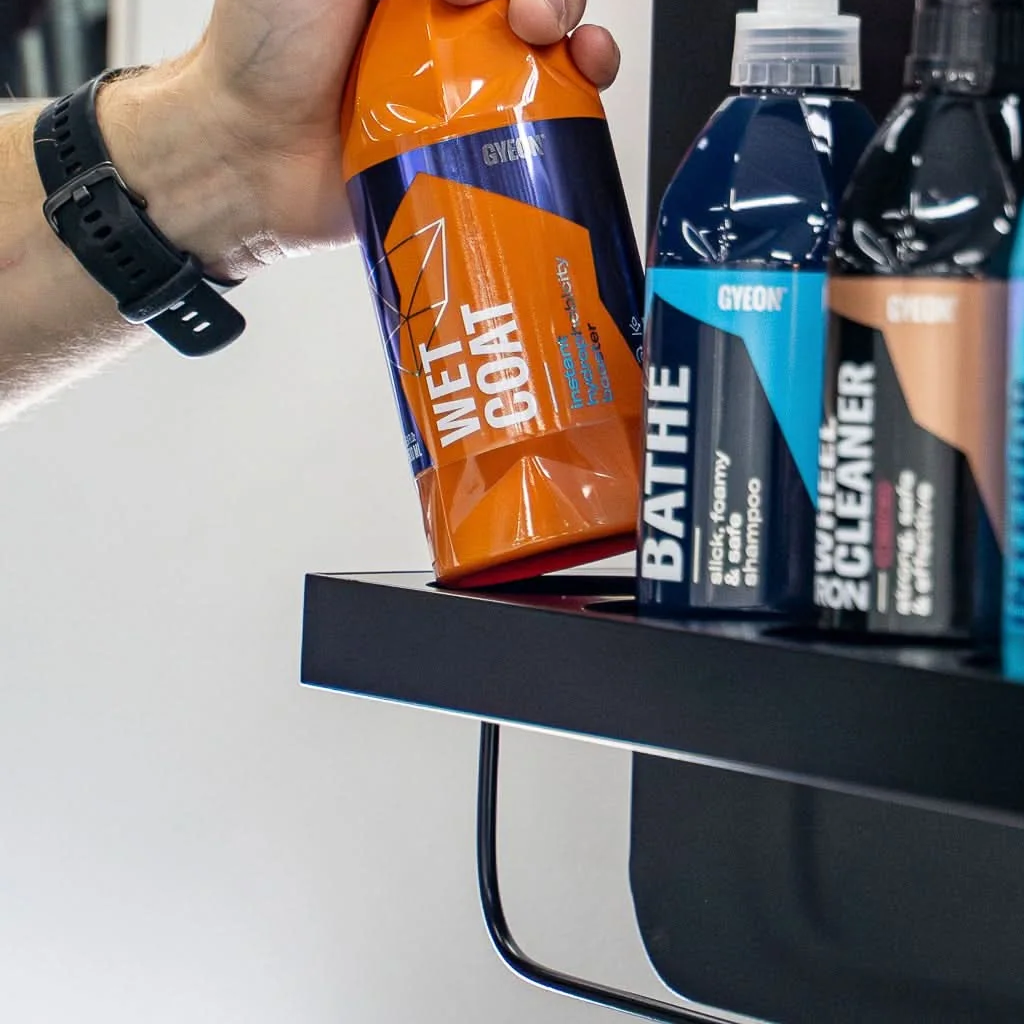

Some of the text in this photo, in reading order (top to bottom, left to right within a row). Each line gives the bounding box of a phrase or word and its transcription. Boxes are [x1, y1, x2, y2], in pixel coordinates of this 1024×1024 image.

[482, 134, 546, 167] GYEON
[717, 284, 789, 312] GYEON
[421, 340, 483, 448] WET
[460, 302, 537, 429] COAT
[557, 336, 584, 409] instant
[587, 323, 615, 403] booster
[641, 365, 691, 583] BATHE
[710, 450, 731, 522] foamy
[834, 361, 875, 579] CLEANER
[725, 511, 743, 587] & safe
[742, 478, 762, 587] shampoo
